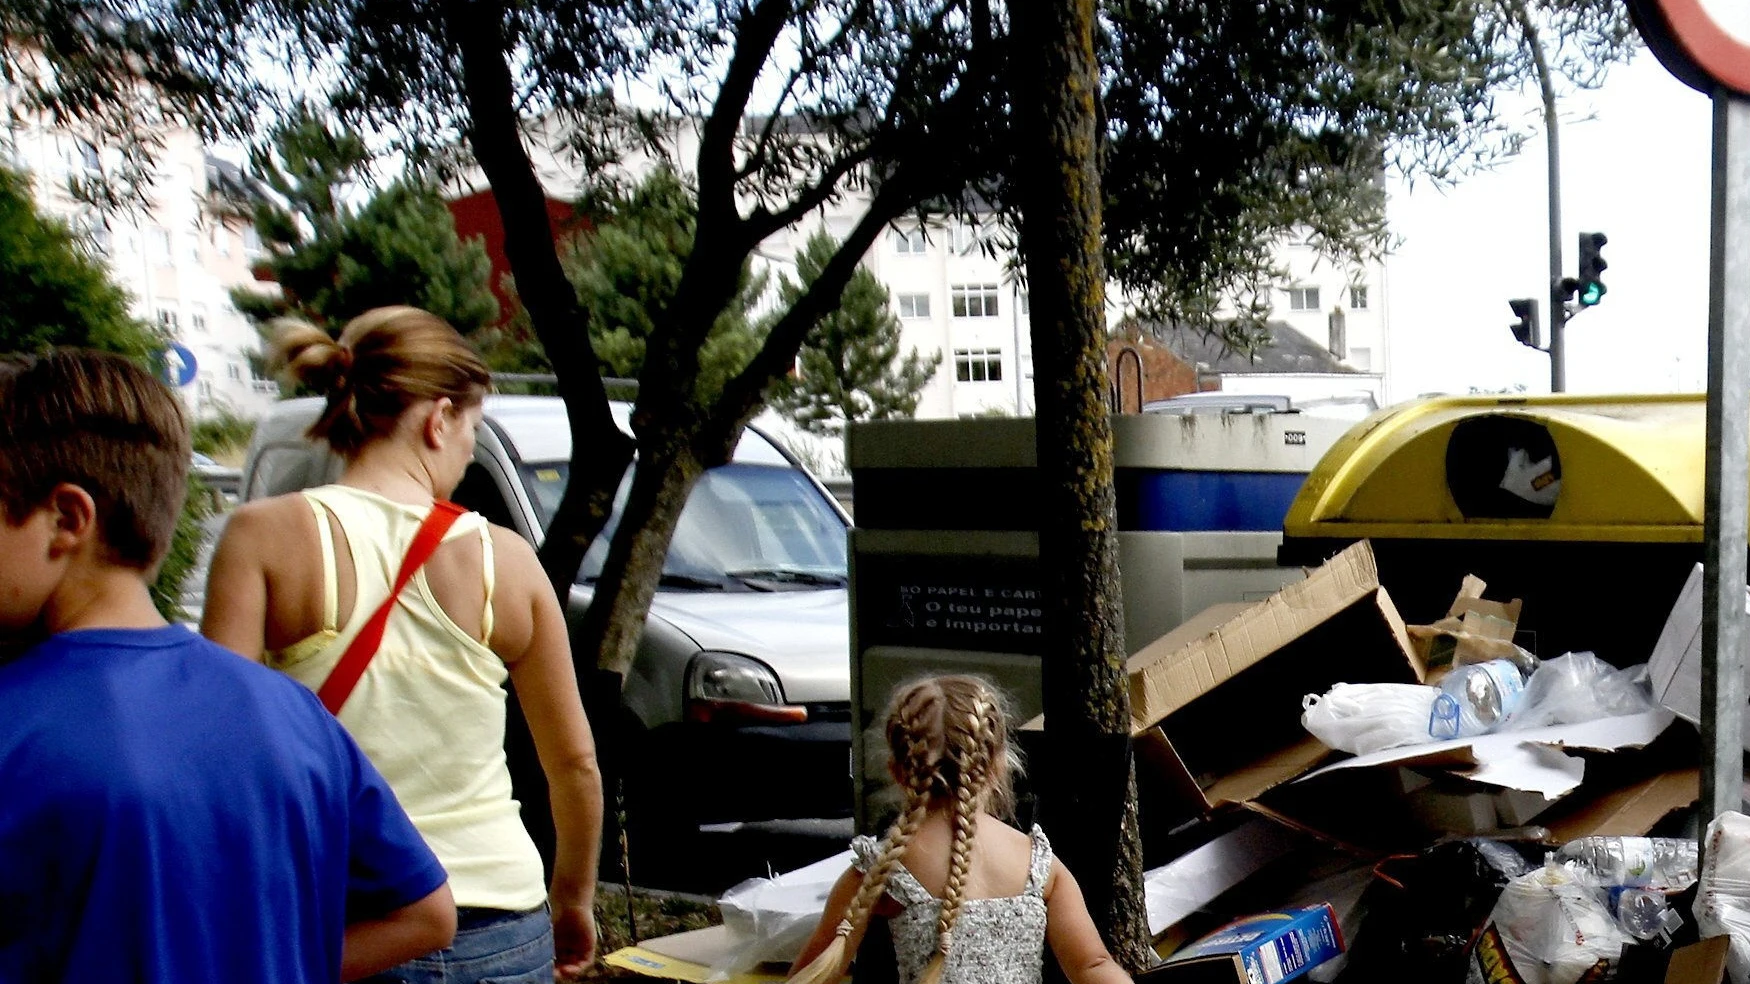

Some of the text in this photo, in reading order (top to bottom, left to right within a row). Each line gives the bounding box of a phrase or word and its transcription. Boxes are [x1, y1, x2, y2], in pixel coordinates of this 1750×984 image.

[927, 586, 975, 596] PAPEL
[925, 601, 941, 612] O
[949, 603, 981, 614] teu
